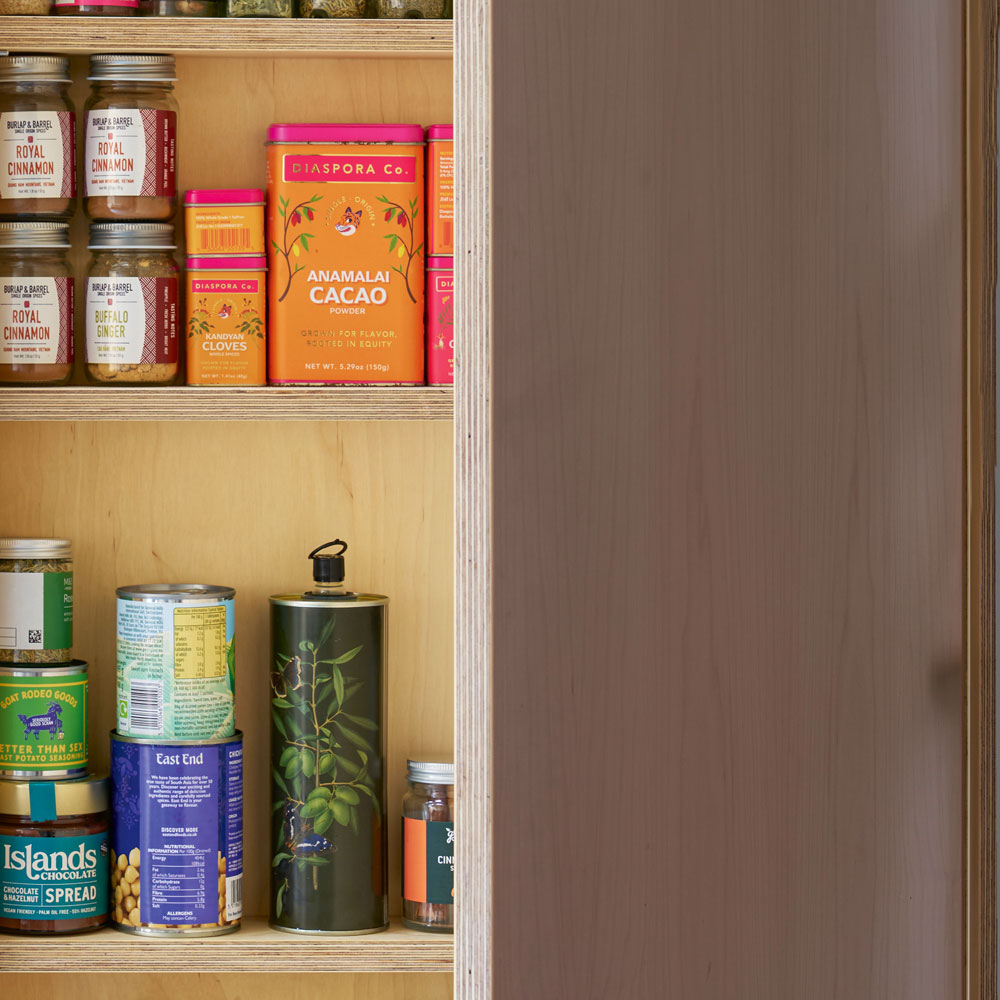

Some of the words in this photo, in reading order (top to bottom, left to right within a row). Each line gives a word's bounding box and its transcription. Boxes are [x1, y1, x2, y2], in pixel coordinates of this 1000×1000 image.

[7, 120, 26, 130] BURLAP
[32, 120, 53, 131] BARREL
[92, 117, 108, 126] BURLAP
[113, 116, 134, 128] BARREL
[16, 145, 45, 159] ROYAL
[98, 141, 125, 155] ROYAL
[7, 161, 54, 176] CINNAMON
[91, 158, 134, 172] CINNAMON
[292, 163, 376, 175] DIASPORA
[383, 164, 409, 175] Co.
[354, 196, 376, 221] ORIGIN
[307, 270, 390, 283] ANAMALAI
[4, 284, 23, 294] BURLAP
[29, 284, 50, 295] BARREL
[92, 283, 108, 292] BURLAP
[112, 283, 133, 293] BARREL
[195, 282, 238, 290] DIASPORA
[309, 286, 387, 305] CACAO
[12, 309, 41, 323] ROYAL
[95, 309, 129, 323] BUFFALO
[329, 307, 366, 315] POWDER
[3, 326, 50, 341] CINNAMON
[97, 325, 126, 338] GINGER
[301, 329, 335, 338] GROWN
[338, 330, 356, 338] FOR
[359, 330, 398, 339] FLAVOR,
[202, 341, 248, 351] CLOVES
[306, 340, 343, 348] ROOTED
[323, 363, 338, 371] WT.
[339, 363, 364, 371] 5.29oz
[366, 363, 390, 372] (150g)
[0, 693, 20, 709] GOAT
[21, 689, 53, 700] RODEO
[54, 690, 78, 708] GOODS
[37, 744, 66, 754] THAN
[69, 742, 83, 753] SEX
[15, 753, 47, 762] POTATO
[156, 753, 180, 765] East
[182, 752, 204, 765] End
[3, 842, 98, 881] Islands
[40, 869, 97, 881] CHOCOLATE
[3, 886, 39, 895] CHOCOLATE
[45, 885, 97, 904] SPREAD
[8, 894, 39, 903] HAZELNUT
